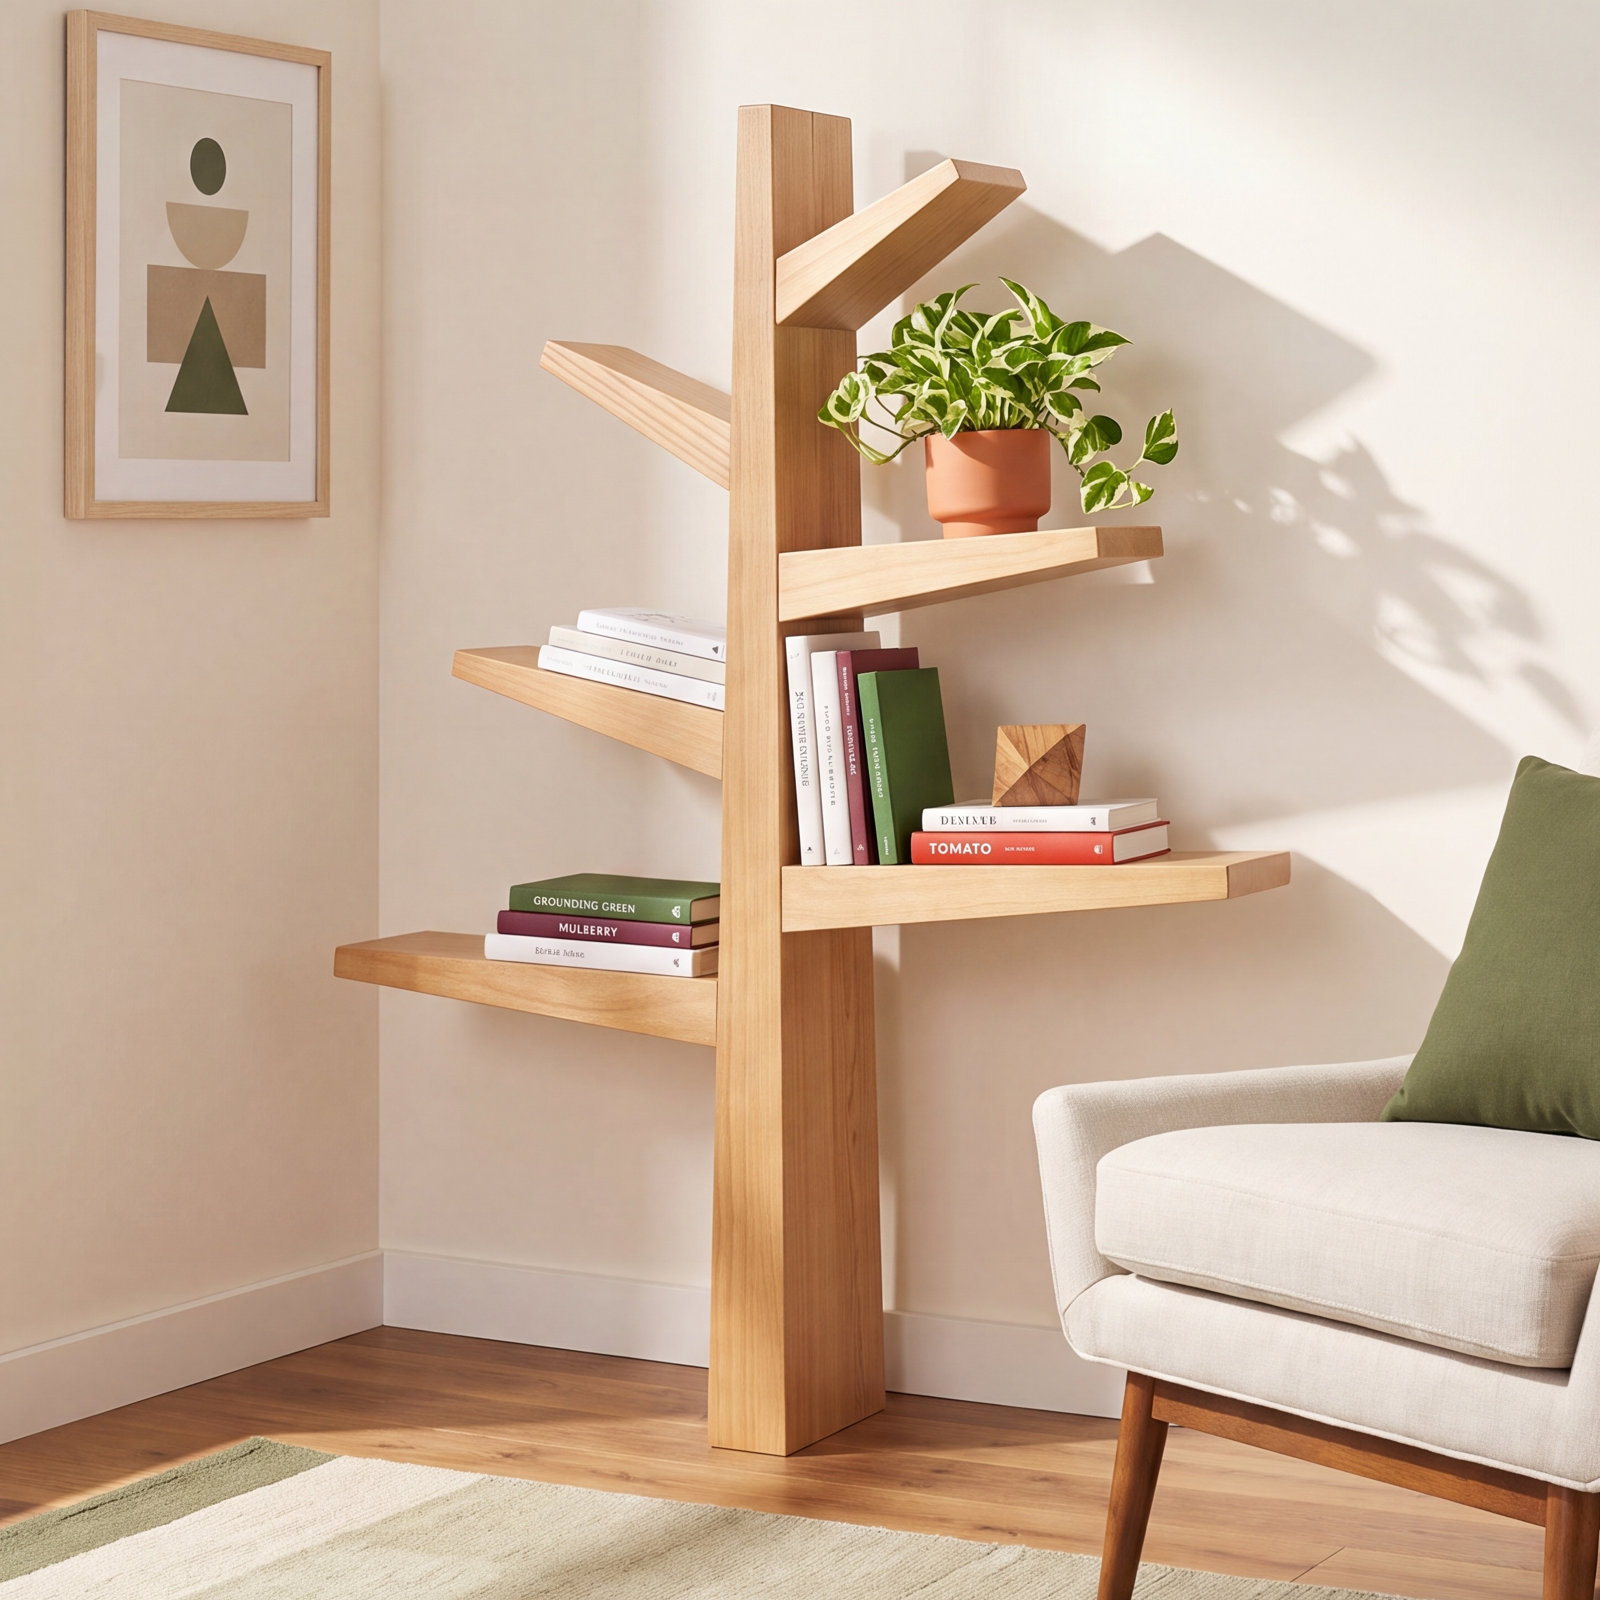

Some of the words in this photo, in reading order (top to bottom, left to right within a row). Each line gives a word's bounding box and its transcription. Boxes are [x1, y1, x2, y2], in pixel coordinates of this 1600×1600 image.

[929, 842, 992, 855] TOMATO
[533, 896, 599, 911] GROUNDING
[601, 902, 635, 914] GREEN
[558, 923, 618, 937] MULBERRY
